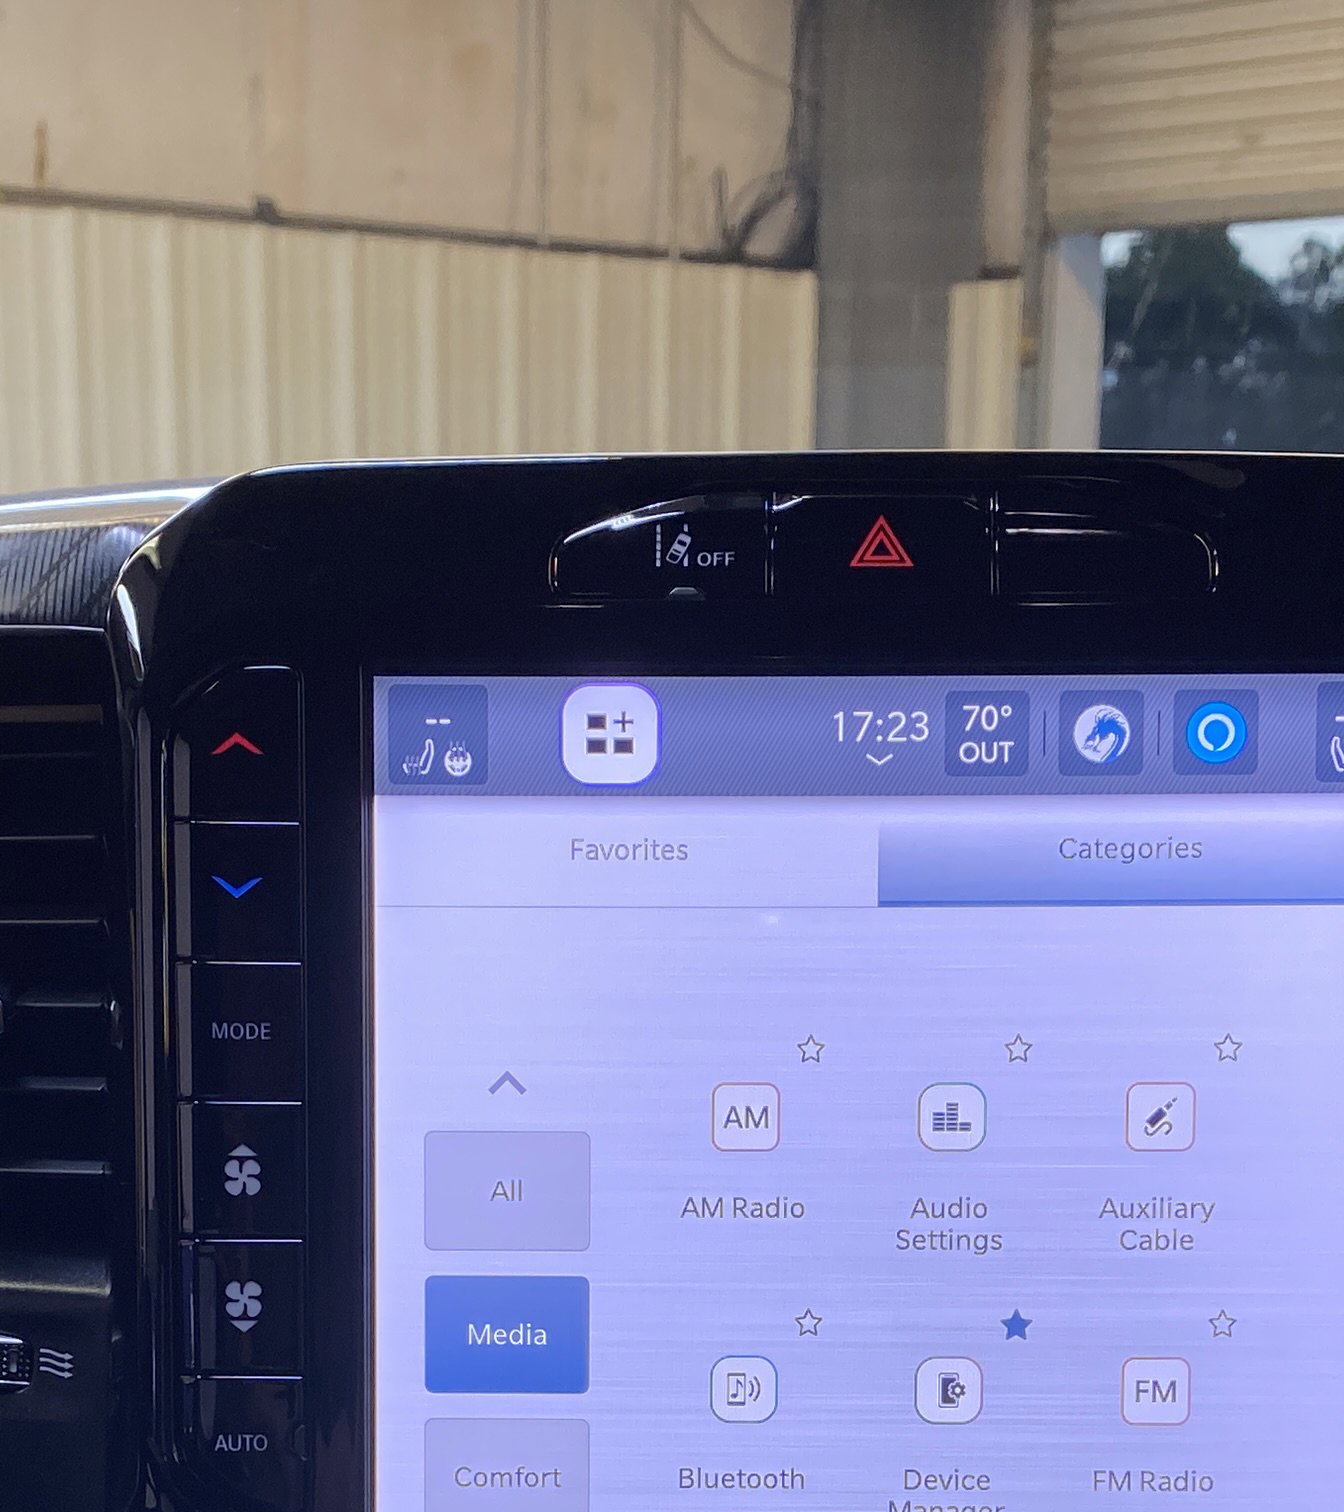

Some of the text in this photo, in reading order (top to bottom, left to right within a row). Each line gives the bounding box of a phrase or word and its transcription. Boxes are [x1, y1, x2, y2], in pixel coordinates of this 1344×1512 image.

[696, 551, 735, 567] OFF
[833, 710, 930, 743] 17:23
[962, 704, 1013, 732] 70°
[959, 741, 1015, 764] OUT
[571, 837, 689, 861] Favorites
[1058, 836, 1202, 865] Categories
[211, 1022, 271, 1040] MODE
[723, 1105, 769, 1129] AM
[489, 1179, 522, 1202] All
[680, 1196, 805, 1219] AM Radio
[910, 1196, 988, 1219] Audio
[1098, 1196, 1216, 1224] Auxiliary
[895, 1228, 1003, 1256] Settings
[1119, 1228, 1194, 1251] Cable
[468, 1322, 547, 1346] Media
[1135, 1379, 1177, 1403] FM
[214, 1434, 268, 1452] AUTO
[454, 1466, 562, 1488] Comfort
[679, 1466, 805, 1490] Bluetooth
[903, 1468, 991, 1491] Device
[1093, 1469, 1214, 1492] FM Radio
